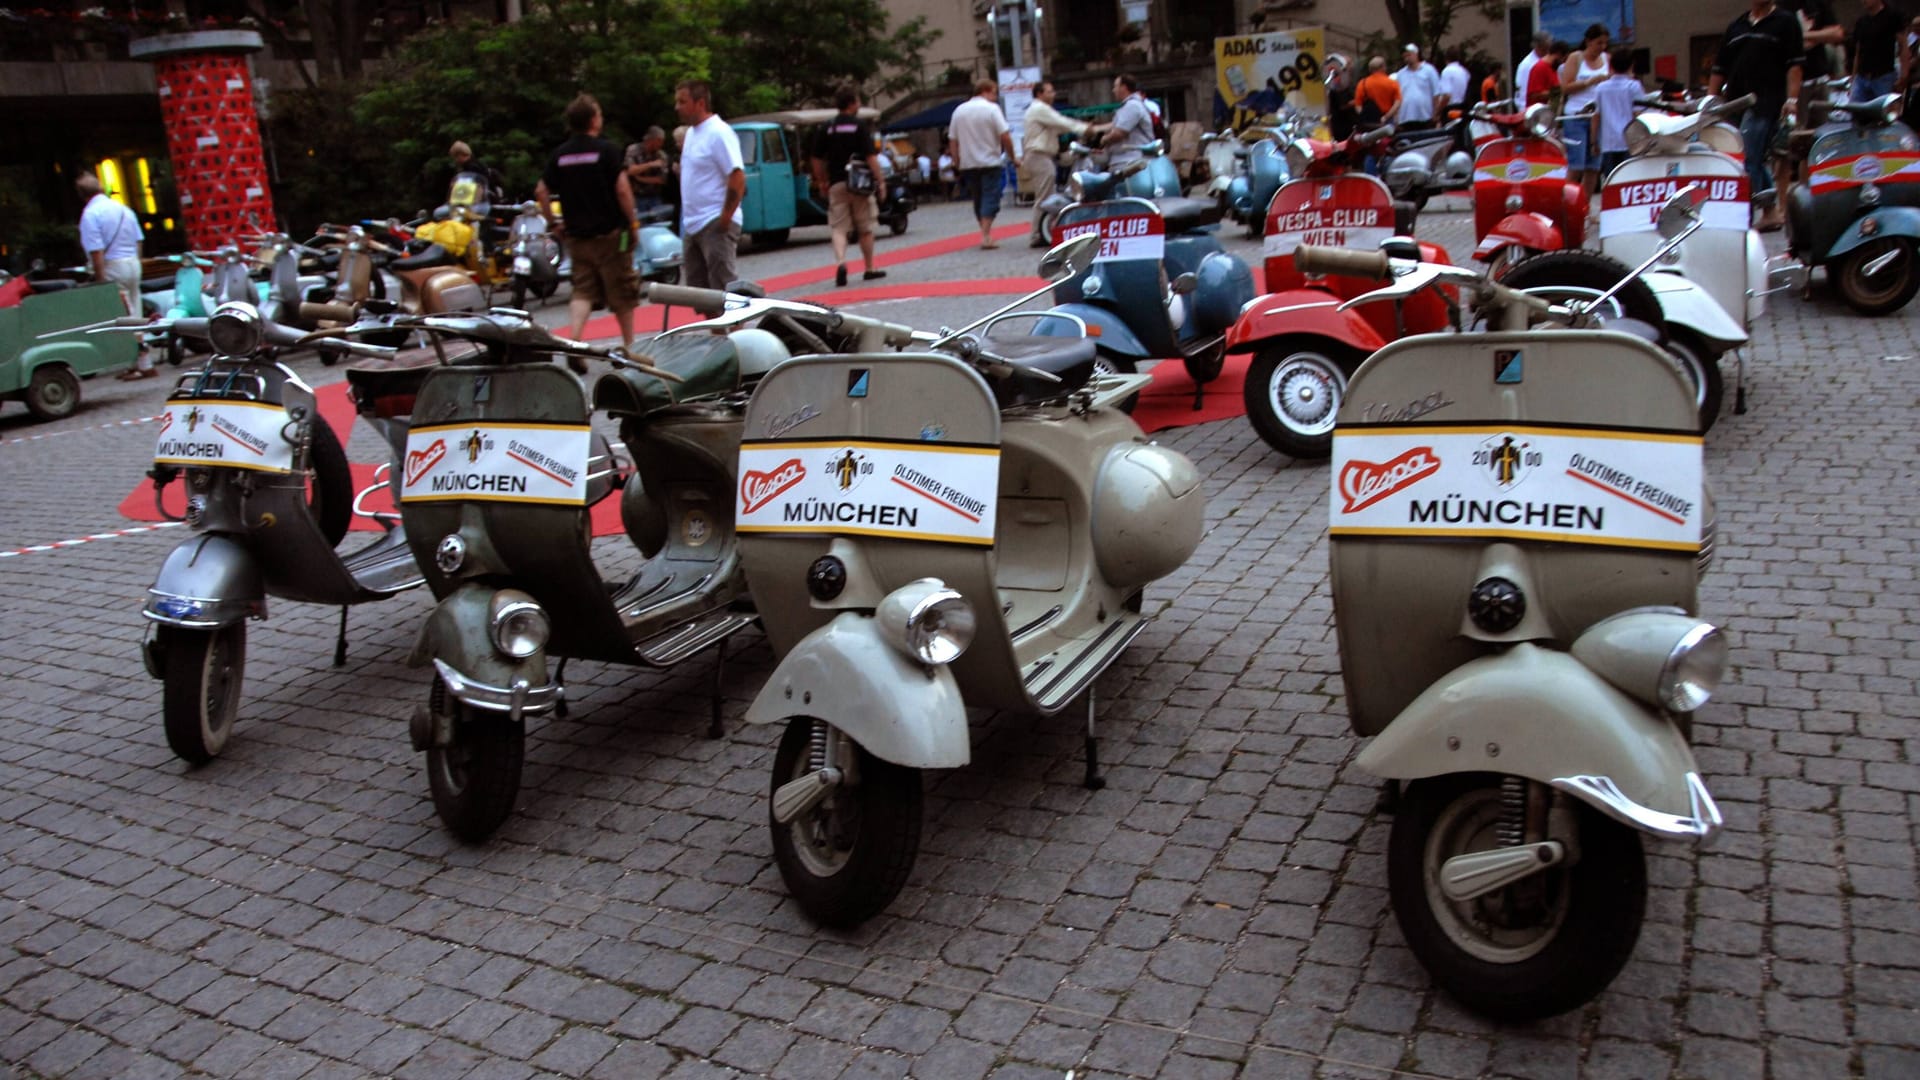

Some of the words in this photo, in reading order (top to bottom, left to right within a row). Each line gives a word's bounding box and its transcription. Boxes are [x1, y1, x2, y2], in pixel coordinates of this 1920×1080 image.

[1223, 38, 1266, 56] ADAC
[1277, 209, 1378, 232] VESPA-CLUB
[1303, 230, 1346, 247] WIEN
[508, 440, 545, 467] OLDTIMER
[543, 457, 579, 483] FREUNDE
[1340, 447, 1440, 514] Vespa
[431, 470, 527, 493] MÜNCHEN
[742, 460, 806, 514] Vespa
[894, 463, 943, 496] OLDTIMER
[941, 486, 988, 517] FREUNDE
[1568, 453, 1635, 491] OLDTIMER
[1633, 481, 1695, 517] FREUNDE
[783, 497, 919, 528] MÜNCHEN
[1408, 493, 1605, 531] MÜNCHEN
